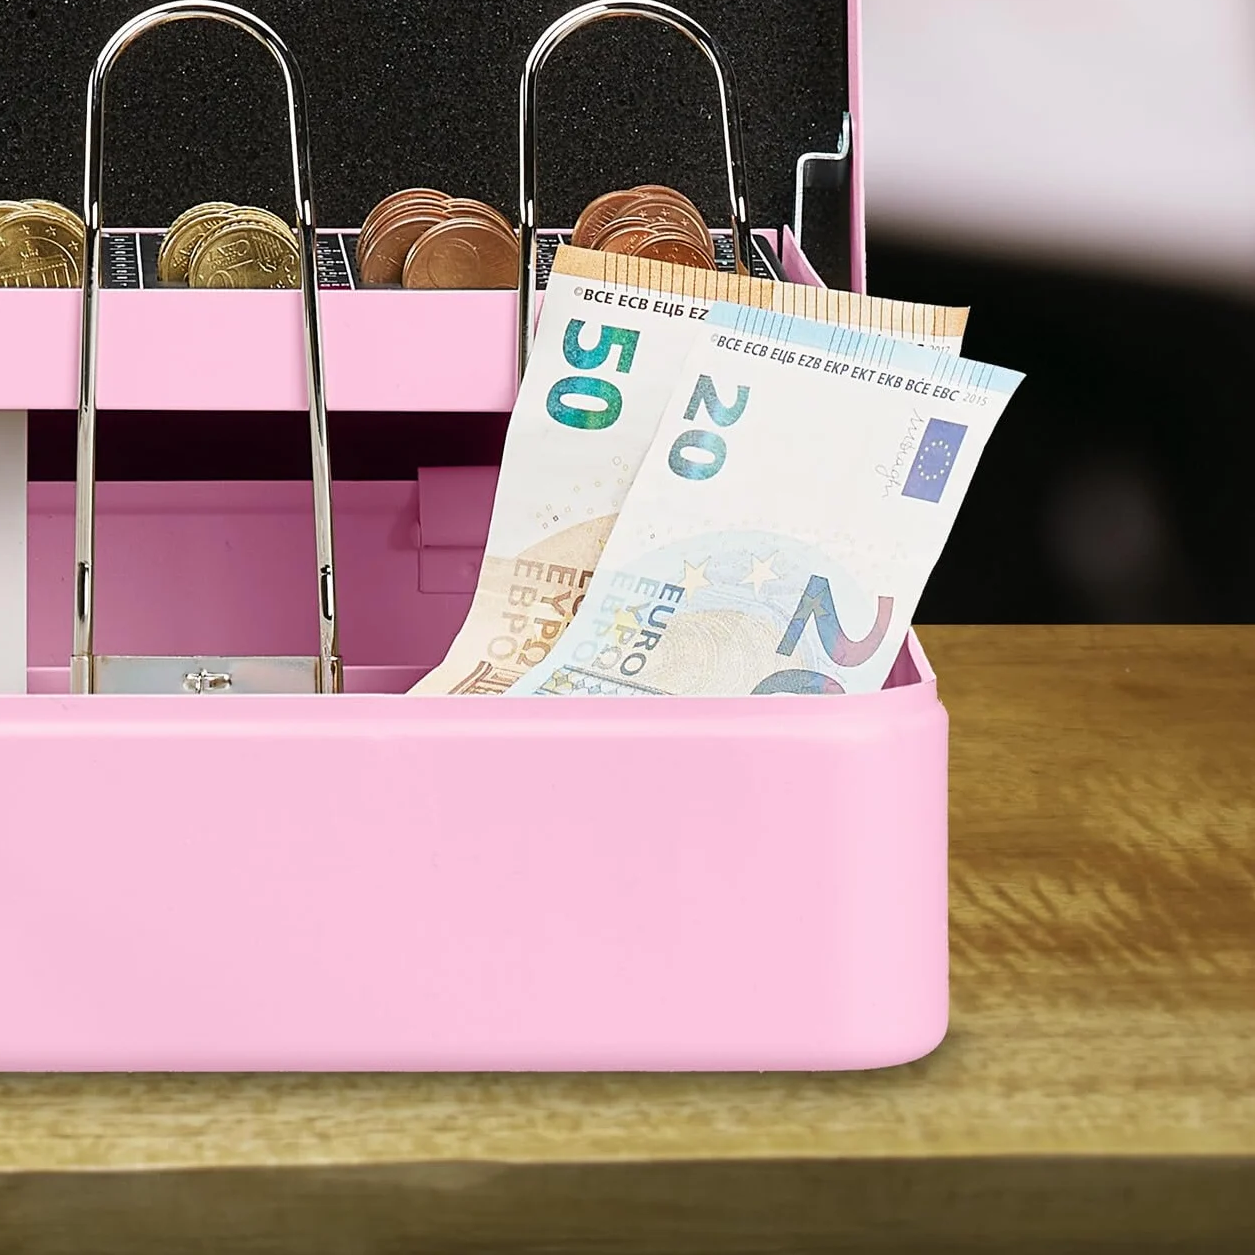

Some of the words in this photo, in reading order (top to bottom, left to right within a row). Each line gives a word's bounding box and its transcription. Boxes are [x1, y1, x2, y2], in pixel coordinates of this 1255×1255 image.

[618, 294, 649, 310] ECB
[545, 318, 640, 430] 50
[743, 341, 769, 357] ECB
[797, 353, 823, 370] EZB
[823, 359, 850, 376] EKP
[850, 366, 876, 382] EKT
[877, 372, 903, 388] EKB
[932, 385, 960, 401] EBC
[962, 392, 989, 407] 2015
[668, 374, 751, 480] 20
[619, 583, 686, 676] EURO
